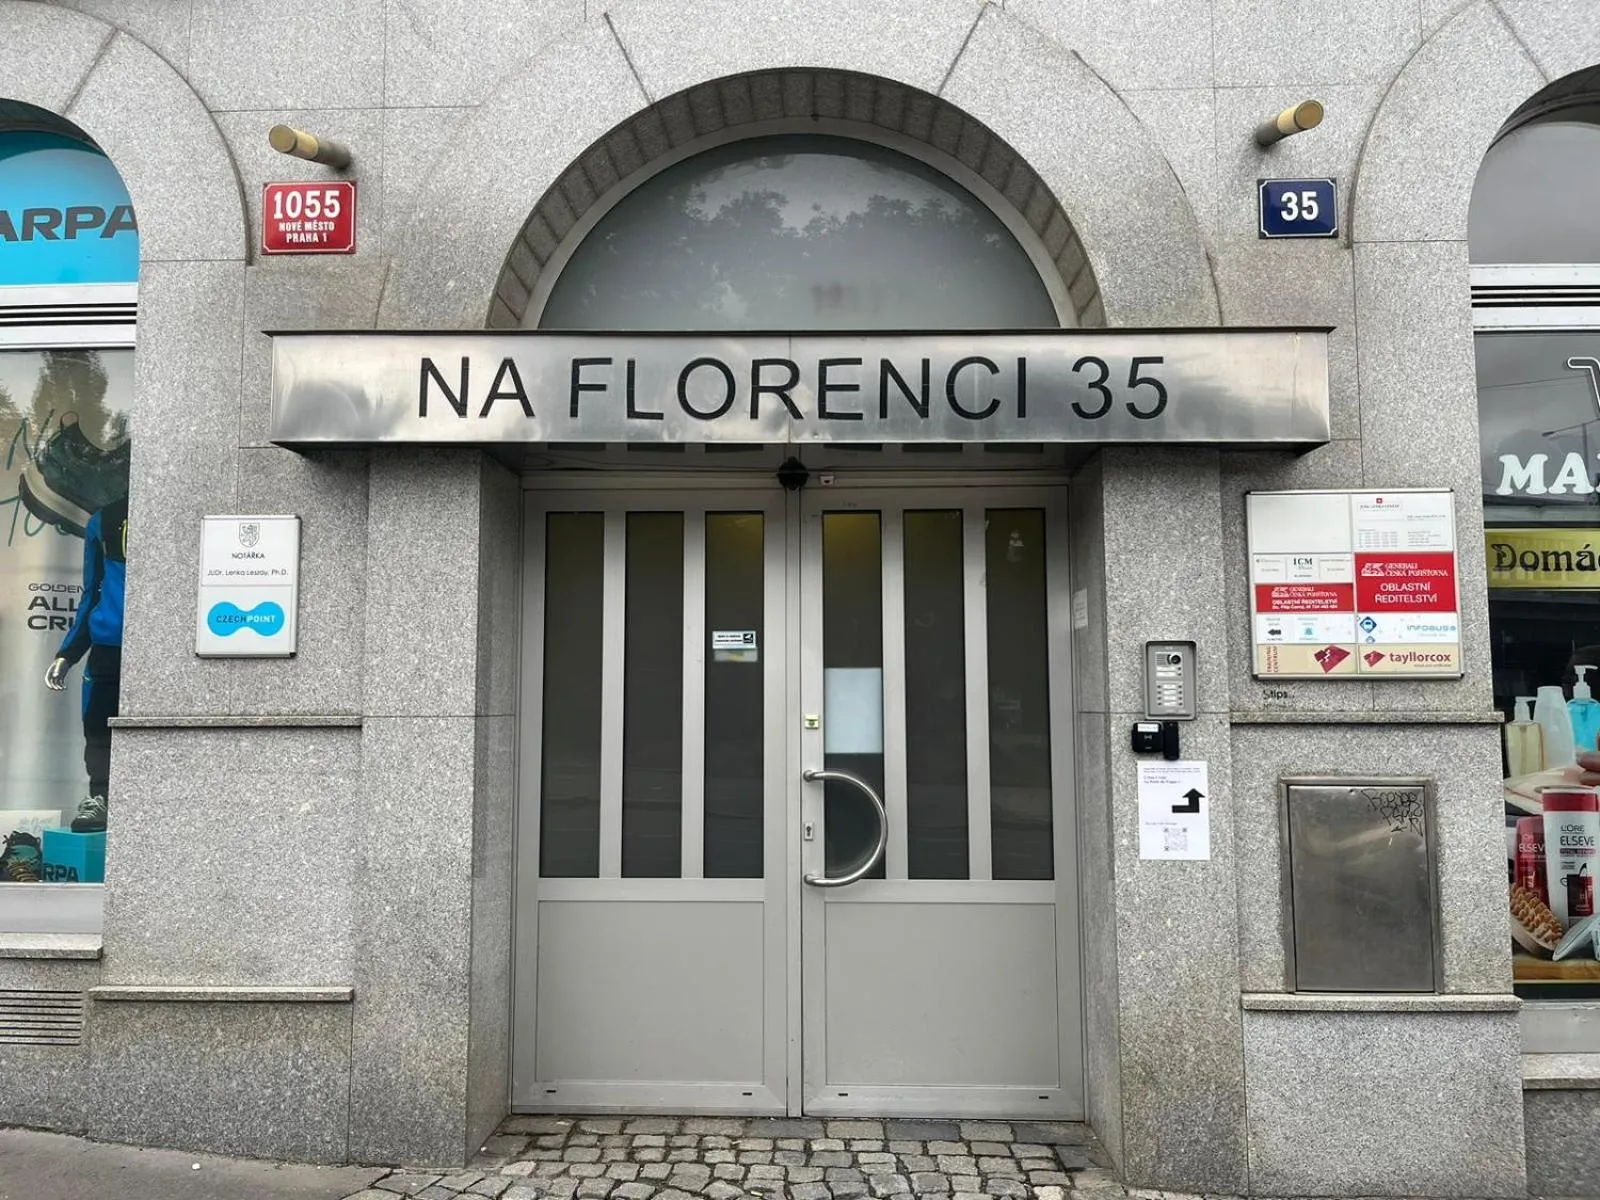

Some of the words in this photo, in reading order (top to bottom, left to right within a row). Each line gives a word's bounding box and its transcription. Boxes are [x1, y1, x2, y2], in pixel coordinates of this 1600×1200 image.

[273, 190, 341, 219] 1055
[1281, 190, 1319, 221] 35
[278, 220, 303, 232] NOVÉ
[304, 219, 335, 232] MĚSTO
[286, 232, 319, 243] PRAHA
[322, 232, 328, 242] 1
[419, 356, 536, 418] NA
[569, 355, 1027, 421] FLORENCI
[1070, 355, 1169, 420] 35
[1495, 452, 1600, 495] MA
[1293, 557, 1313, 566] ICM
[1490, 543, 1600, 573] Domá
[1380, 581, 1431, 592] OBLASTNÍ
[28, 596, 79, 612] ALL
[1375, 592, 1438, 604] ŘEDITELSTVÍ
[1389, 651, 1452, 665] tayllorcox
